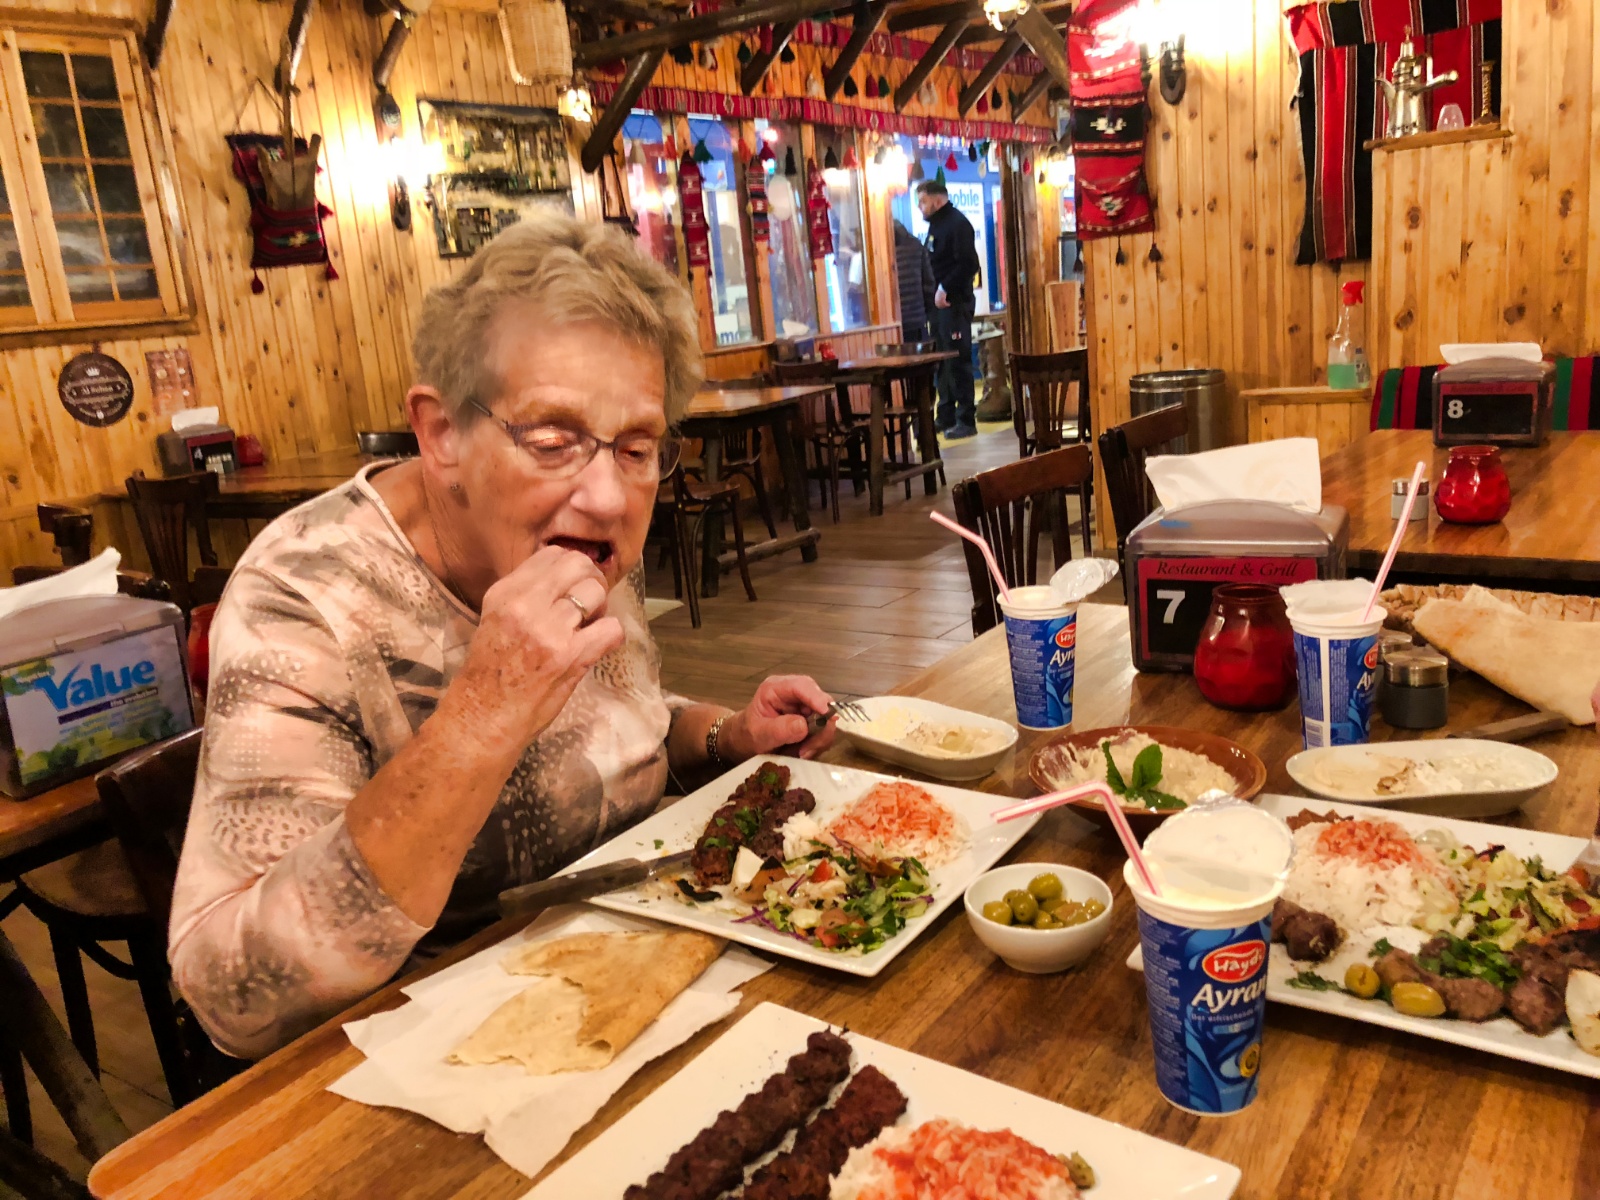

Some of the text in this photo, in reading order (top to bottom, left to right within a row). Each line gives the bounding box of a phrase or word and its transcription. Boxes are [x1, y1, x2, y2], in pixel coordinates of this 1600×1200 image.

[1447, 399, 1464, 419] 8
[1156, 561, 1299, 577] Restaurant & Grill
[1156, 589, 1186, 624] 7
[34, 660, 156, 712] Value
